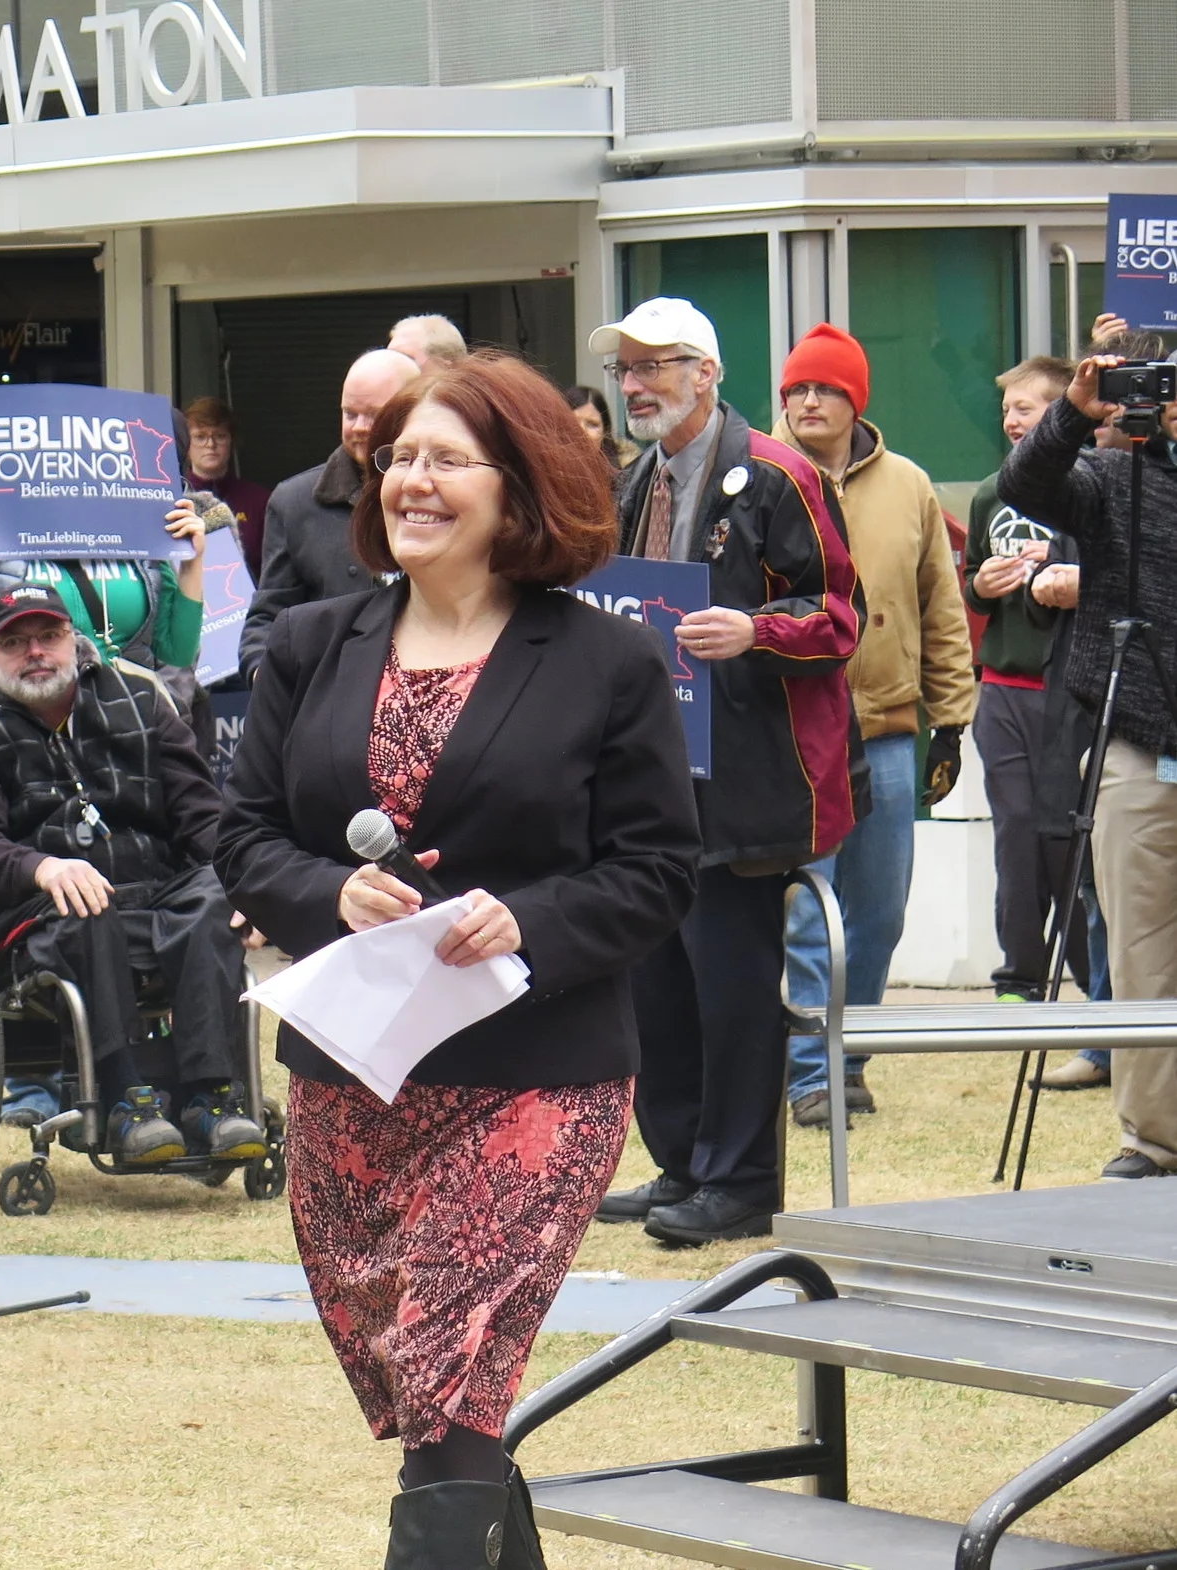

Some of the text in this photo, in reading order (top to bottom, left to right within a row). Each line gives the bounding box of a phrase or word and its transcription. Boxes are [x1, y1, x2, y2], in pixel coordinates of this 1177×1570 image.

[1117, 246, 1129, 269] FOR
[23, 322, 72, 346] Flair
[20, 481, 175, 501] Believe in Minnesota
[18, 531, 122, 547] TinaLiebling.com
